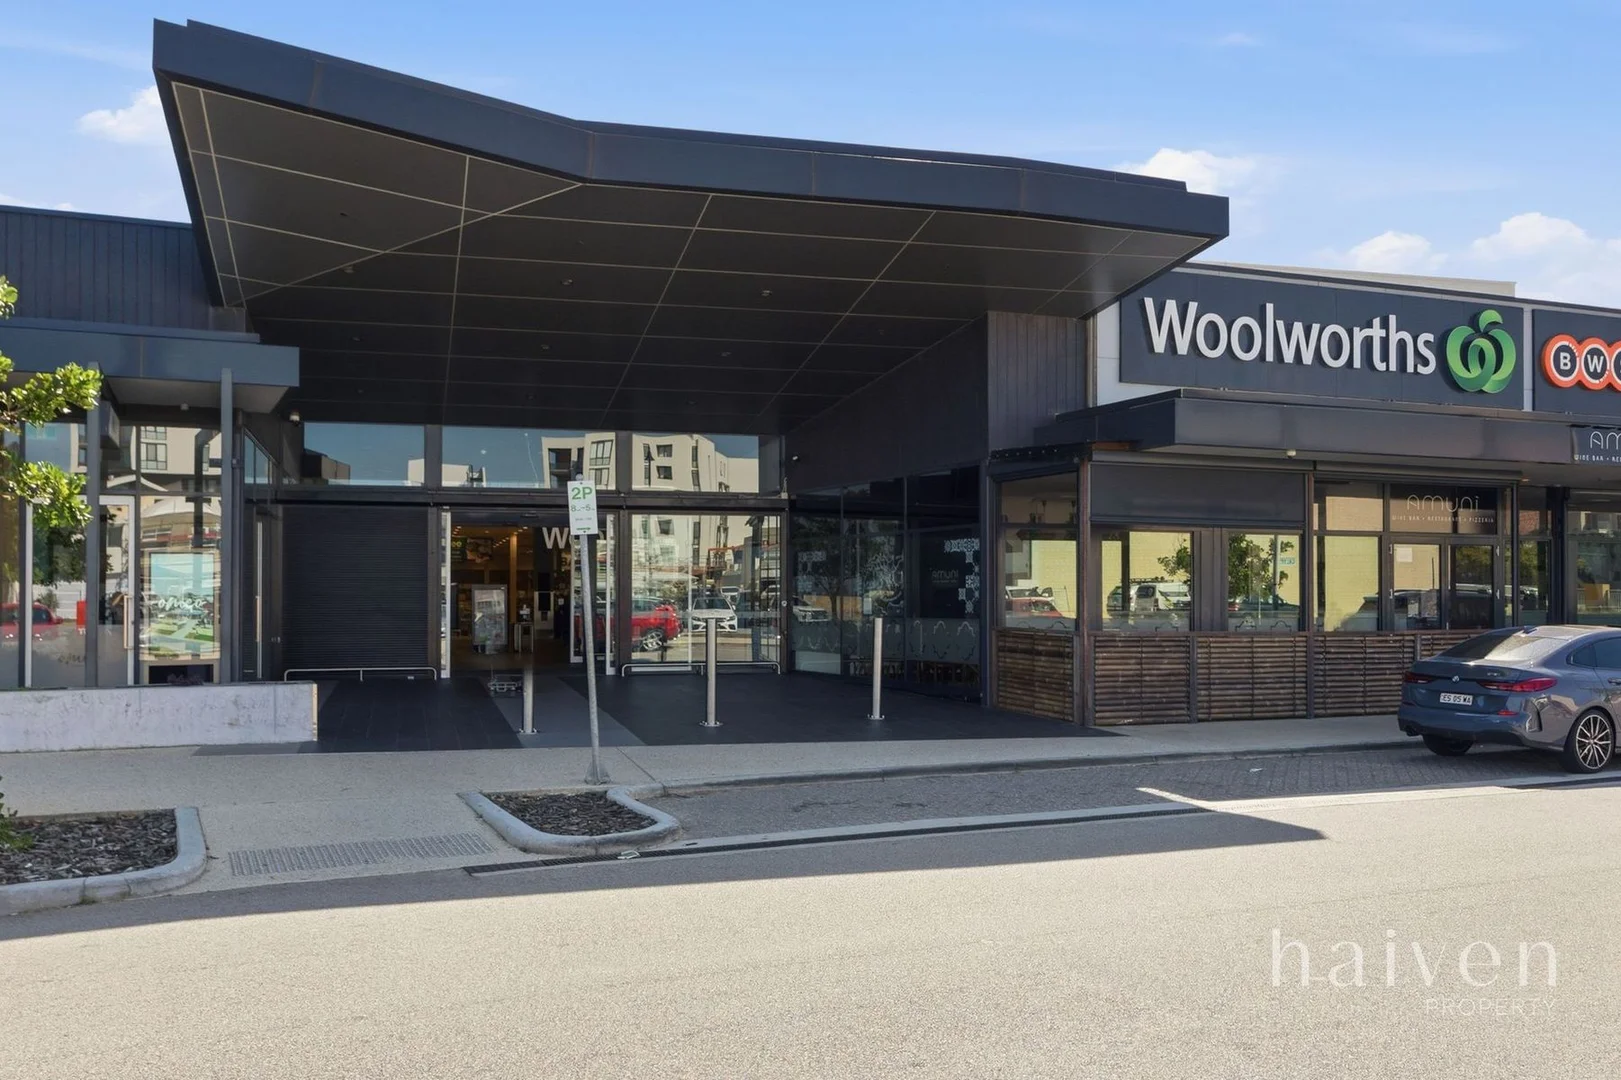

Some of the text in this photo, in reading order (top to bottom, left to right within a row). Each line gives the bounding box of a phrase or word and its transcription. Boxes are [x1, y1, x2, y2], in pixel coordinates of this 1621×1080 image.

[1144, 297, 1436, 375] Woolworths
[1560, 351, 1621, 373] BW
[571, 486, 593, 500] 2P
